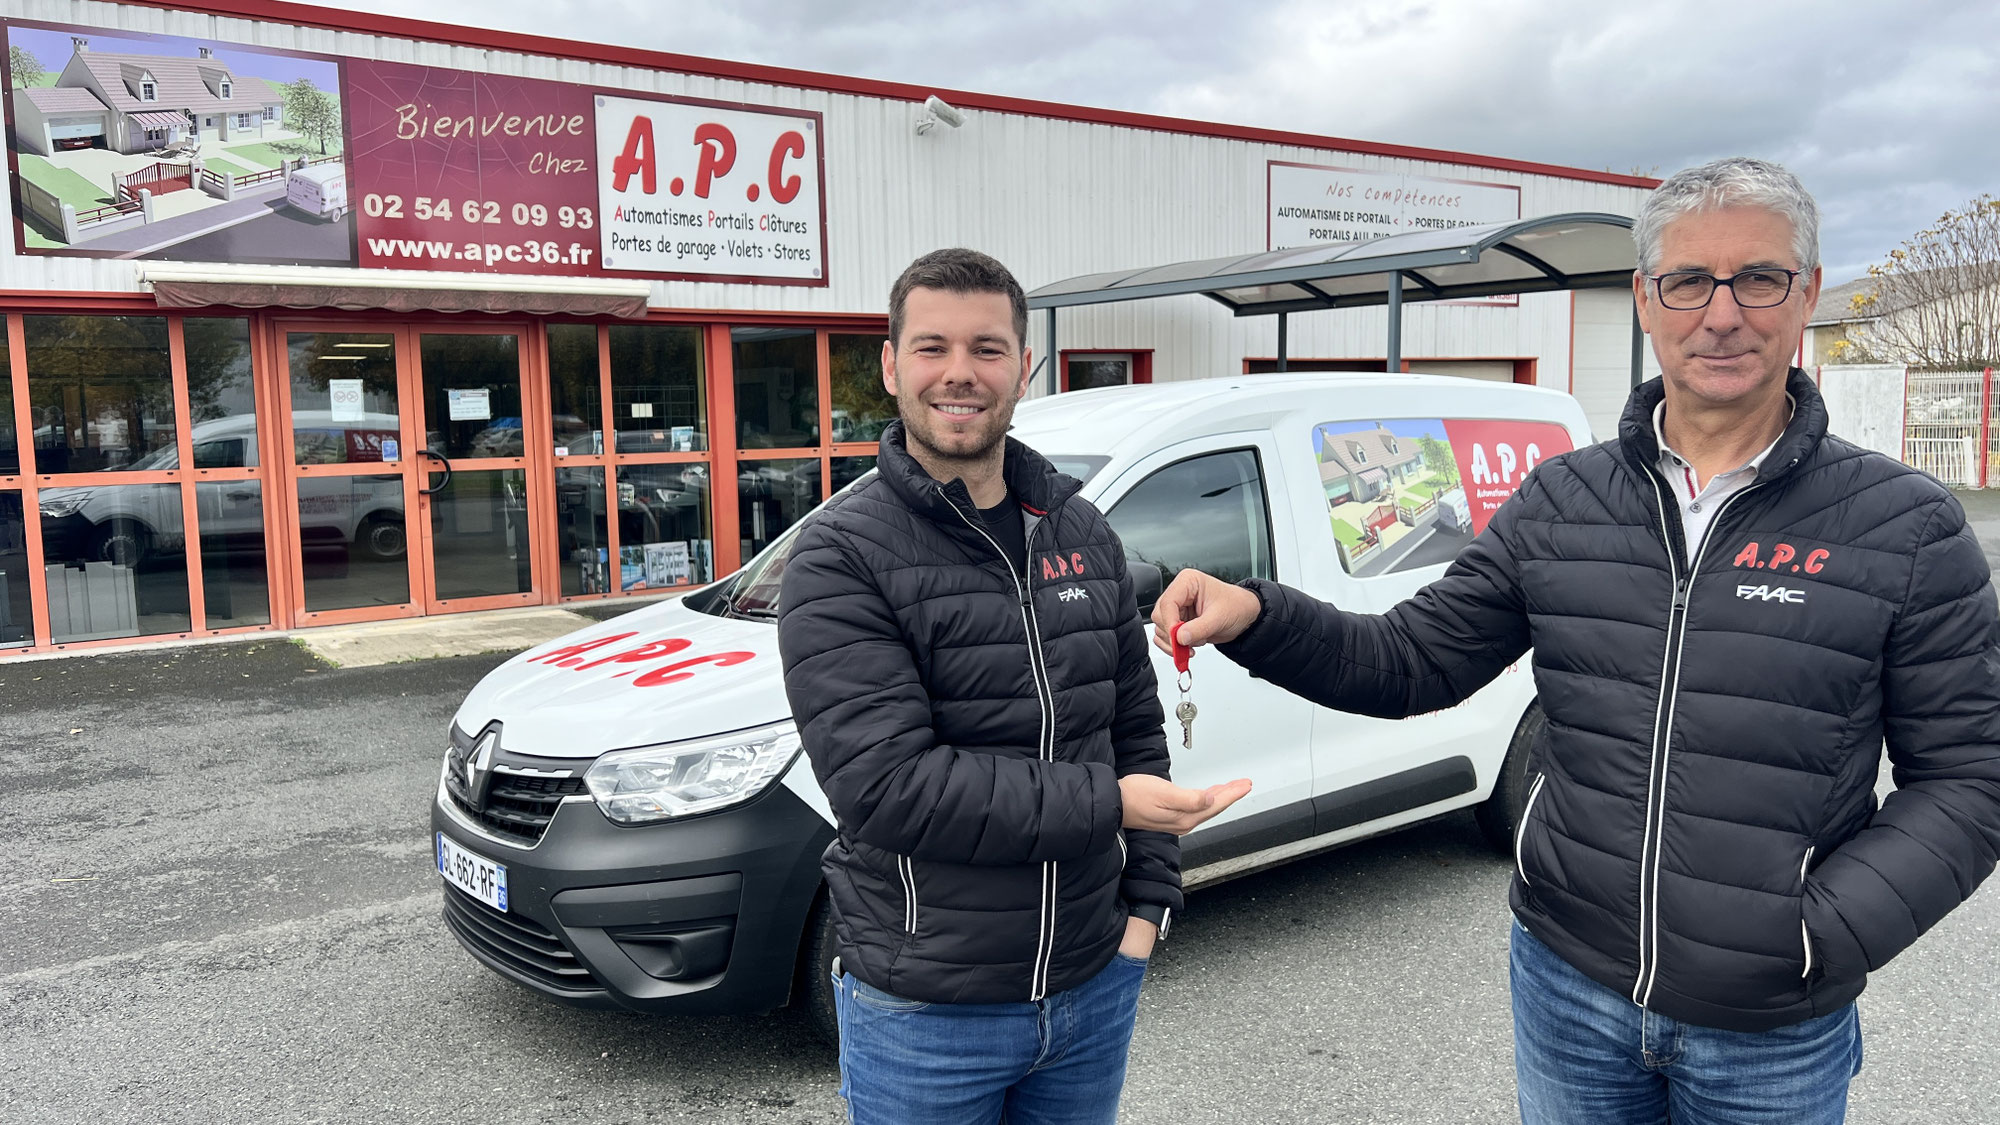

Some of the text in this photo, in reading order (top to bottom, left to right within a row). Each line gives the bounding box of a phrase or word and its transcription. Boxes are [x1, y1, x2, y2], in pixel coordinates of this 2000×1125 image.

[395, 103, 584, 139] Bienvenue
[528, 152, 588, 175] Chez
[612, 115, 805, 204] A.P.C
[1326, 181, 1354, 198] Nos
[363, 193, 594, 229] 02 54 62 09 93
[614, 205, 808, 234] Automatismes Portails Clôtures
[1277, 206, 1391, 225] AUTOMATISME DE PORTAIL
[1415, 217, 1445, 229] PORTES
[612, 232, 811, 261] Portes de garage Volets Stores
[1309, 228, 1350, 241] PORTAILS
[367, 238, 593, 267] www.apc36.fr
[1042, 552, 1085, 580] A.P.C
[1732, 541, 1830, 575] A.P.C
[1736, 584, 1807, 604] FAAC
[526, 631, 757, 688] A.P.C
[442, 842, 496, 899] GL-662-RF
